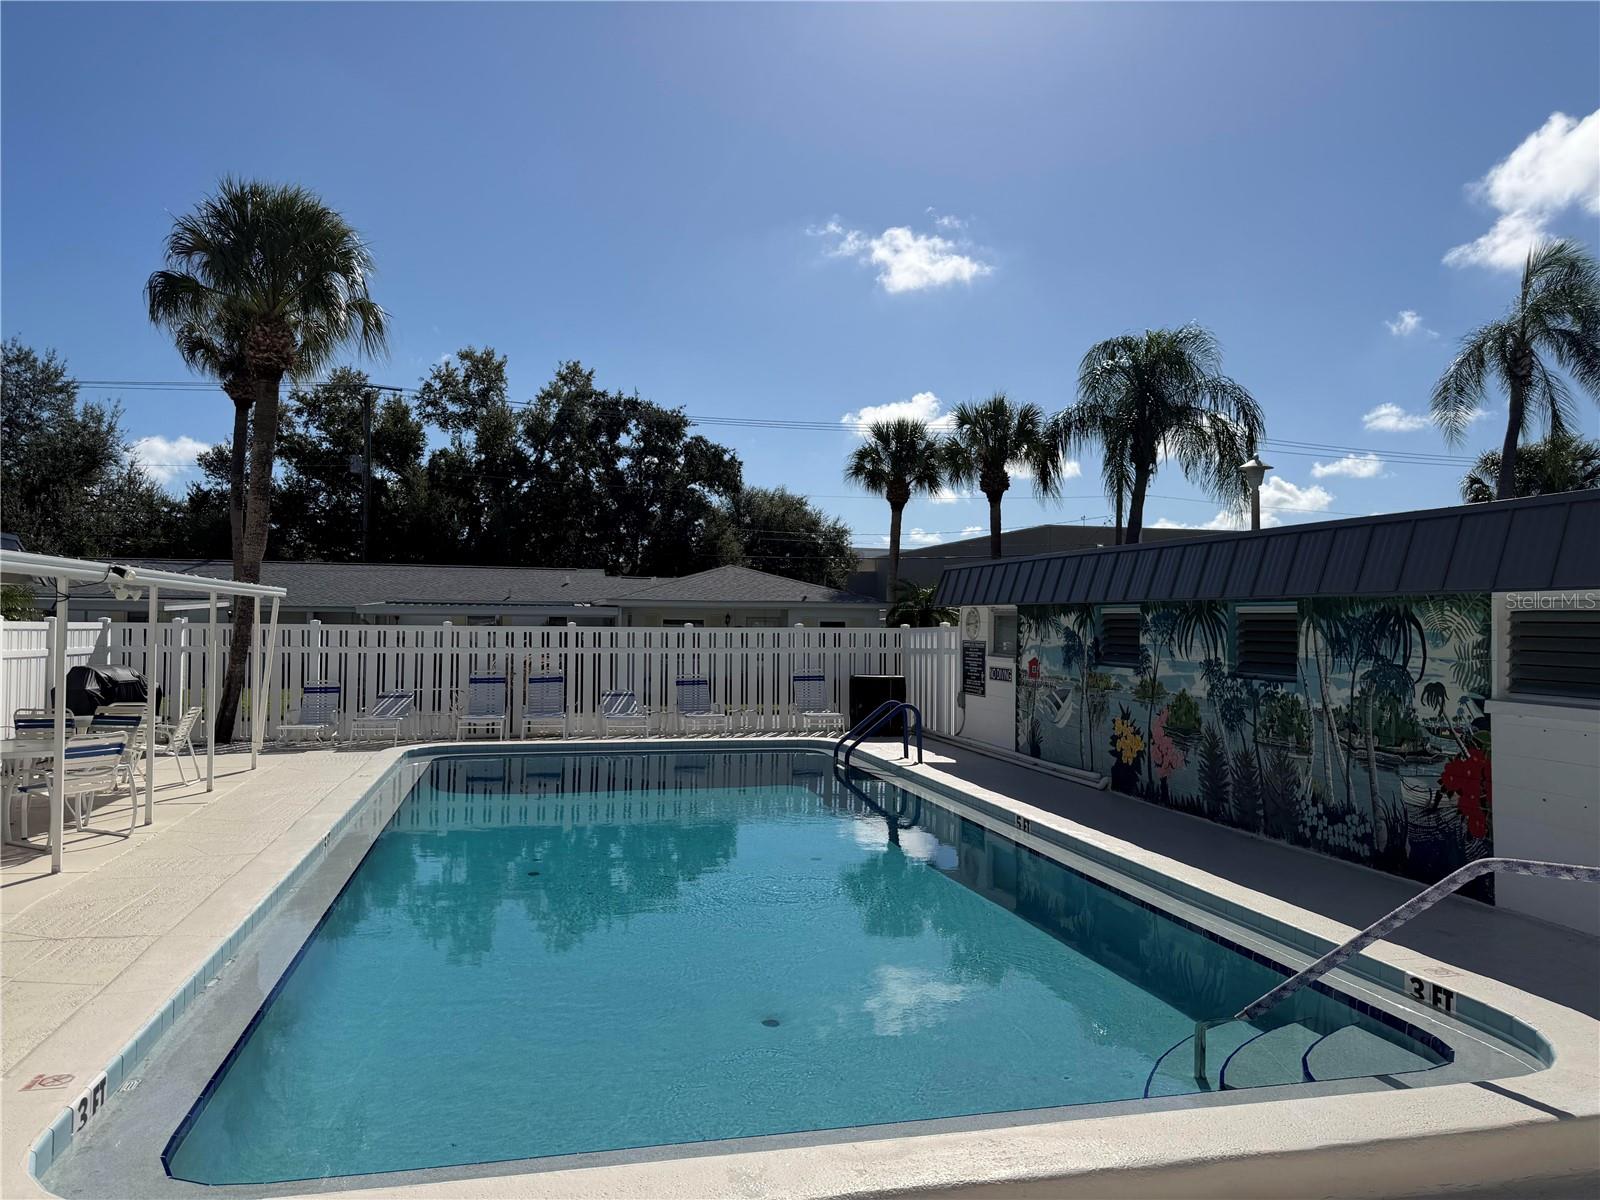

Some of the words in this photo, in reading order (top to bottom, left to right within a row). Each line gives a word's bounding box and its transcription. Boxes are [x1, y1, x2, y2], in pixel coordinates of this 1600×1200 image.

[996, 668, 1012, 682] DIVING
[1409, 977, 1425, 1000] 3
[1432, 984, 1454, 1012] FT
[76, 1096, 89, 1132] 3
[92, 1076, 107, 1117] FT
